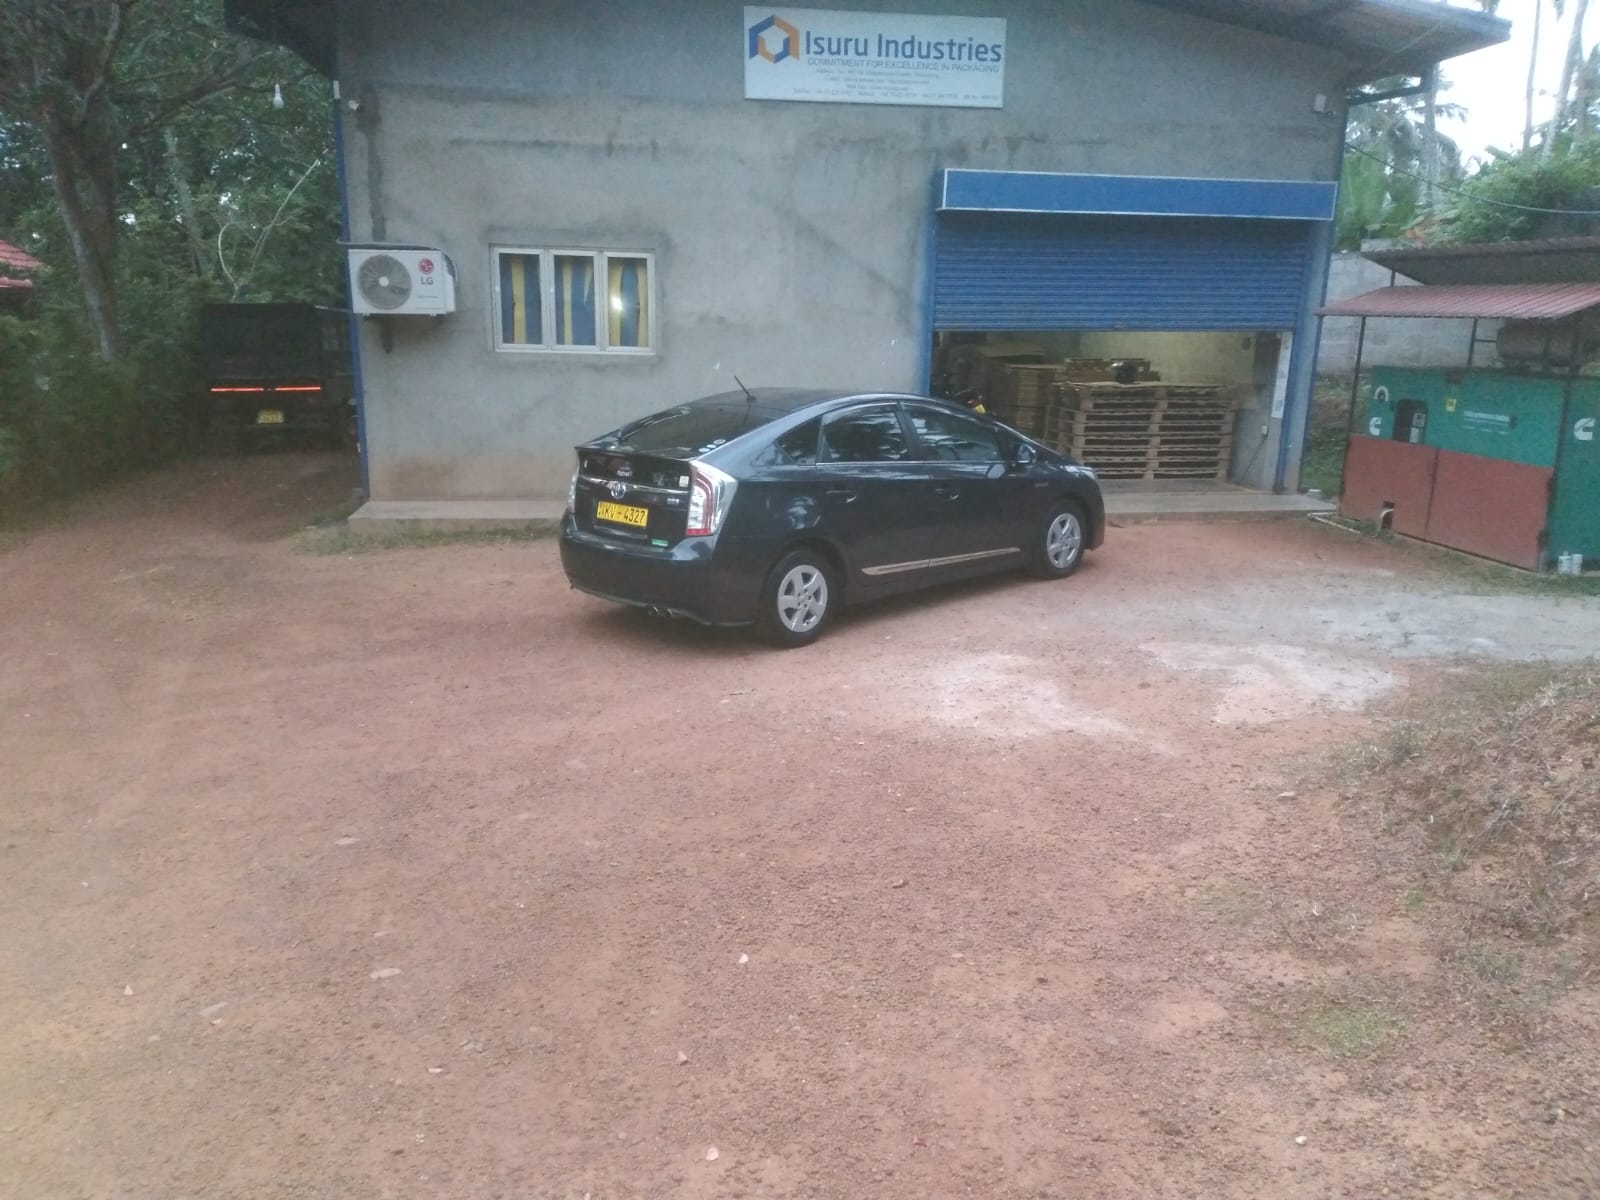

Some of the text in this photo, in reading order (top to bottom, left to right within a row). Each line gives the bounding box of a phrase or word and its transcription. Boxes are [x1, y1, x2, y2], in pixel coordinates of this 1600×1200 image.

[805, 31, 1002, 62] Isuru Industries
[866, 60, 883, 69] FOR
[885, 61, 939, 71] EXCELLENCE
[941, 63, 949, 72] IN
[952, 63, 1000, 73] PACKAGING
[420, 277, 433, 285] LG
